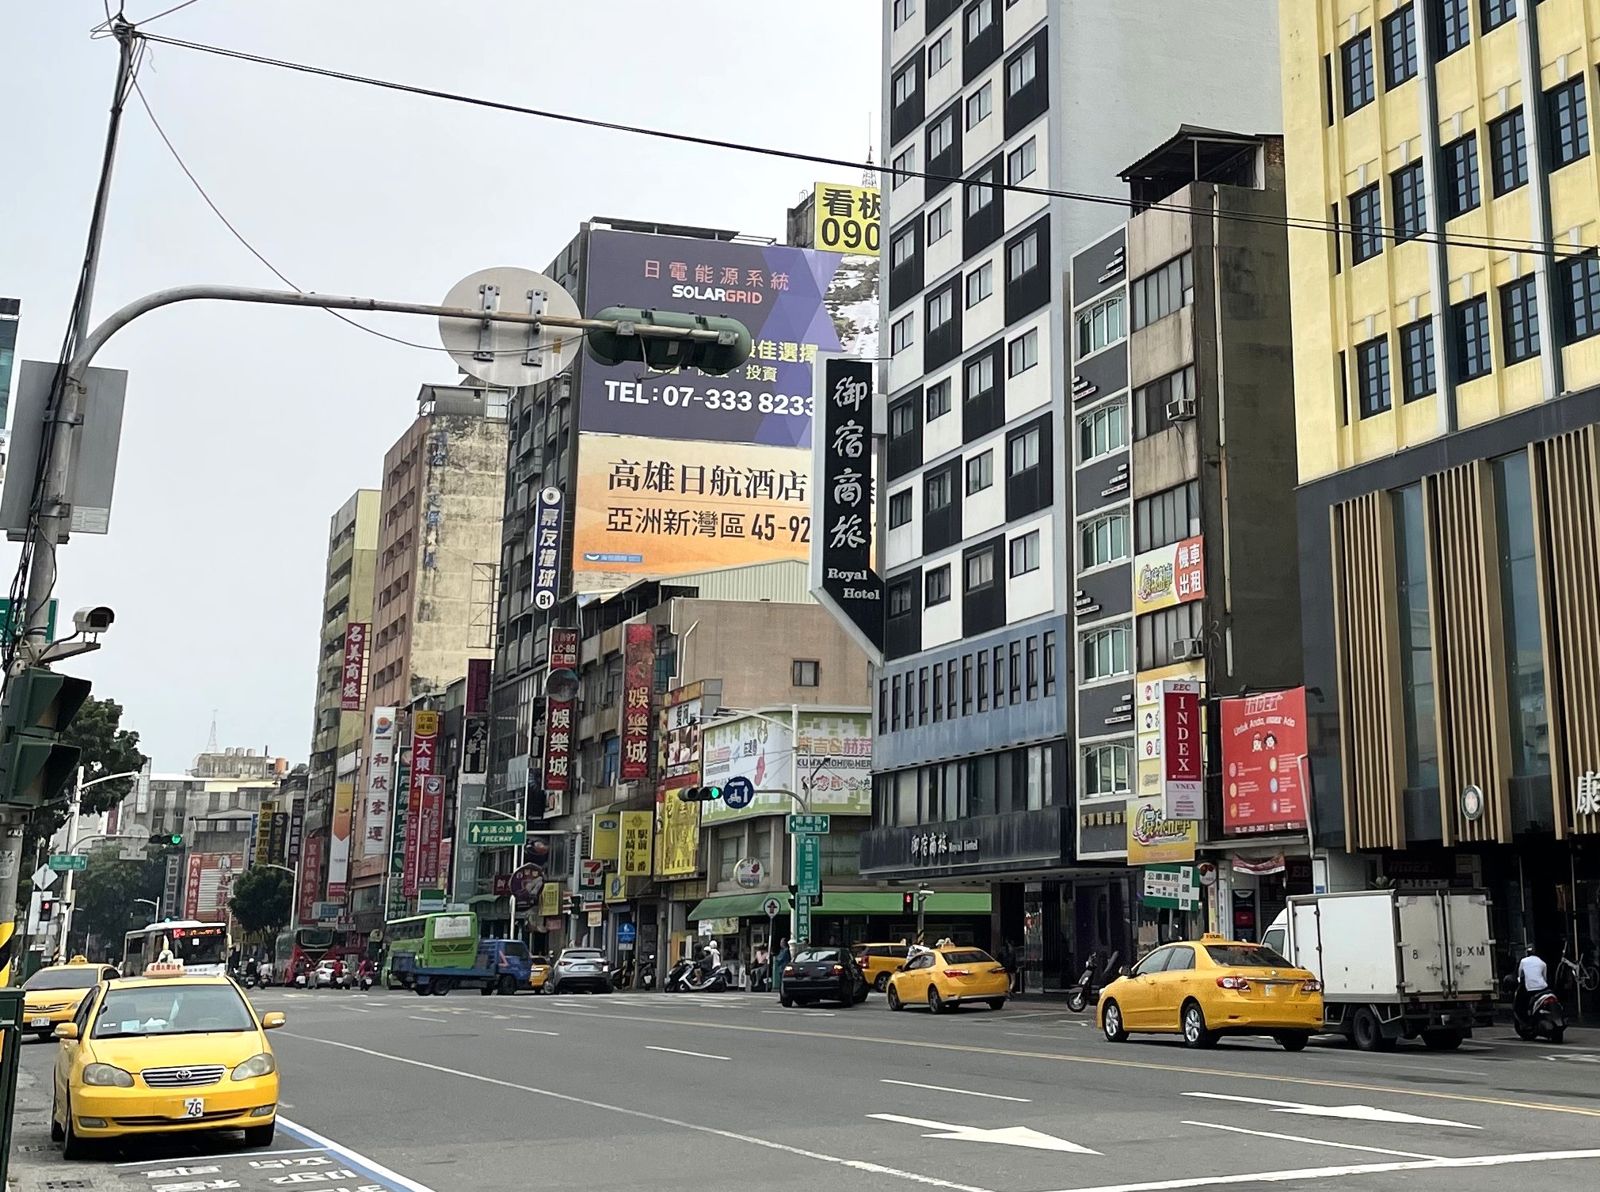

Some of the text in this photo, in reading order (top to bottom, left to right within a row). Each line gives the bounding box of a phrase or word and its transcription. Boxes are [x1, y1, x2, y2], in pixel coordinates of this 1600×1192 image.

[822, 187, 880, 220] 看板
[644, 259, 789, 291] 日電能源系統
[672, 284, 762, 304] SOLARGRID
[746, 364, 777, 383] 投資
[829, 376, 868, 549] 御宿商旅
[608, 459, 808, 502] 高雄日航酒店
[606, 506, 745, 539] 亞洲新灣區
[1178, 543, 1201, 569] 機車
[827, 568, 867, 582] Royal
[1179, 570, 1202, 596] 出租
[540, 594, 552, 606] B1
[843, 587, 880, 601] Hotel
[1172, 684, 1192, 692] EEC
[626, 686, 649, 764] 娛樂城
[1177, 696, 1190, 772] INDEX
[548, 708, 570, 777] 娛樂城
[367, 753, 390, 842] 和欣客運
